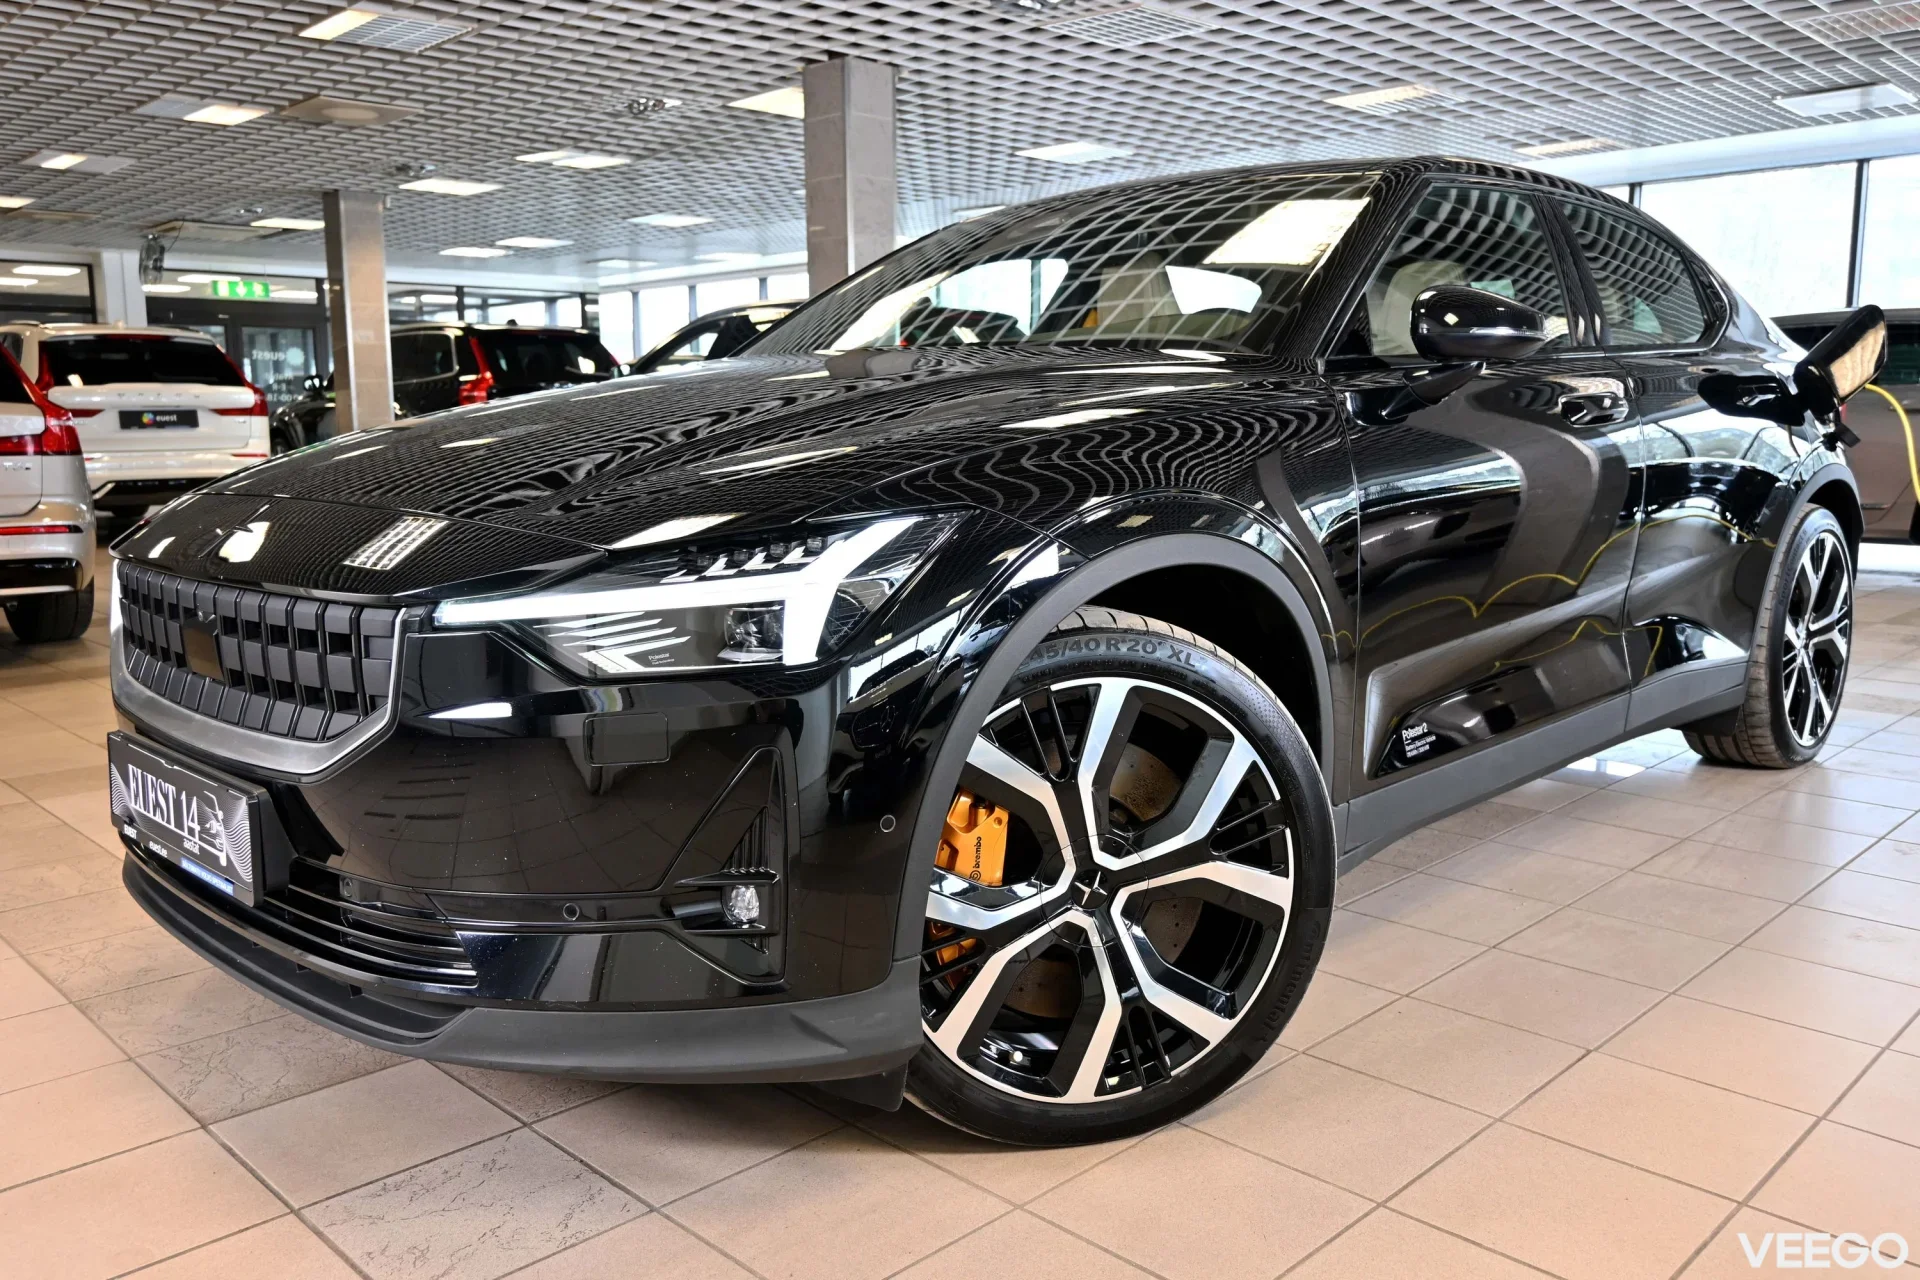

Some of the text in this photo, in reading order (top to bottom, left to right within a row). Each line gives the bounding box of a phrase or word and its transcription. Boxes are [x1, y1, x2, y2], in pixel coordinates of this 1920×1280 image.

[155, 413, 178, 423] euest
[1018, 637, 1101, 669] 45/40
[1167, 644, 1197, 668] XL
[1402, 722, 1429, 740] Polestar 2
[127, 763, 201, 843] EUEST 14
[972, 836, 983, 869] brembo
[1263, 920, 1321, 1031] Continental
